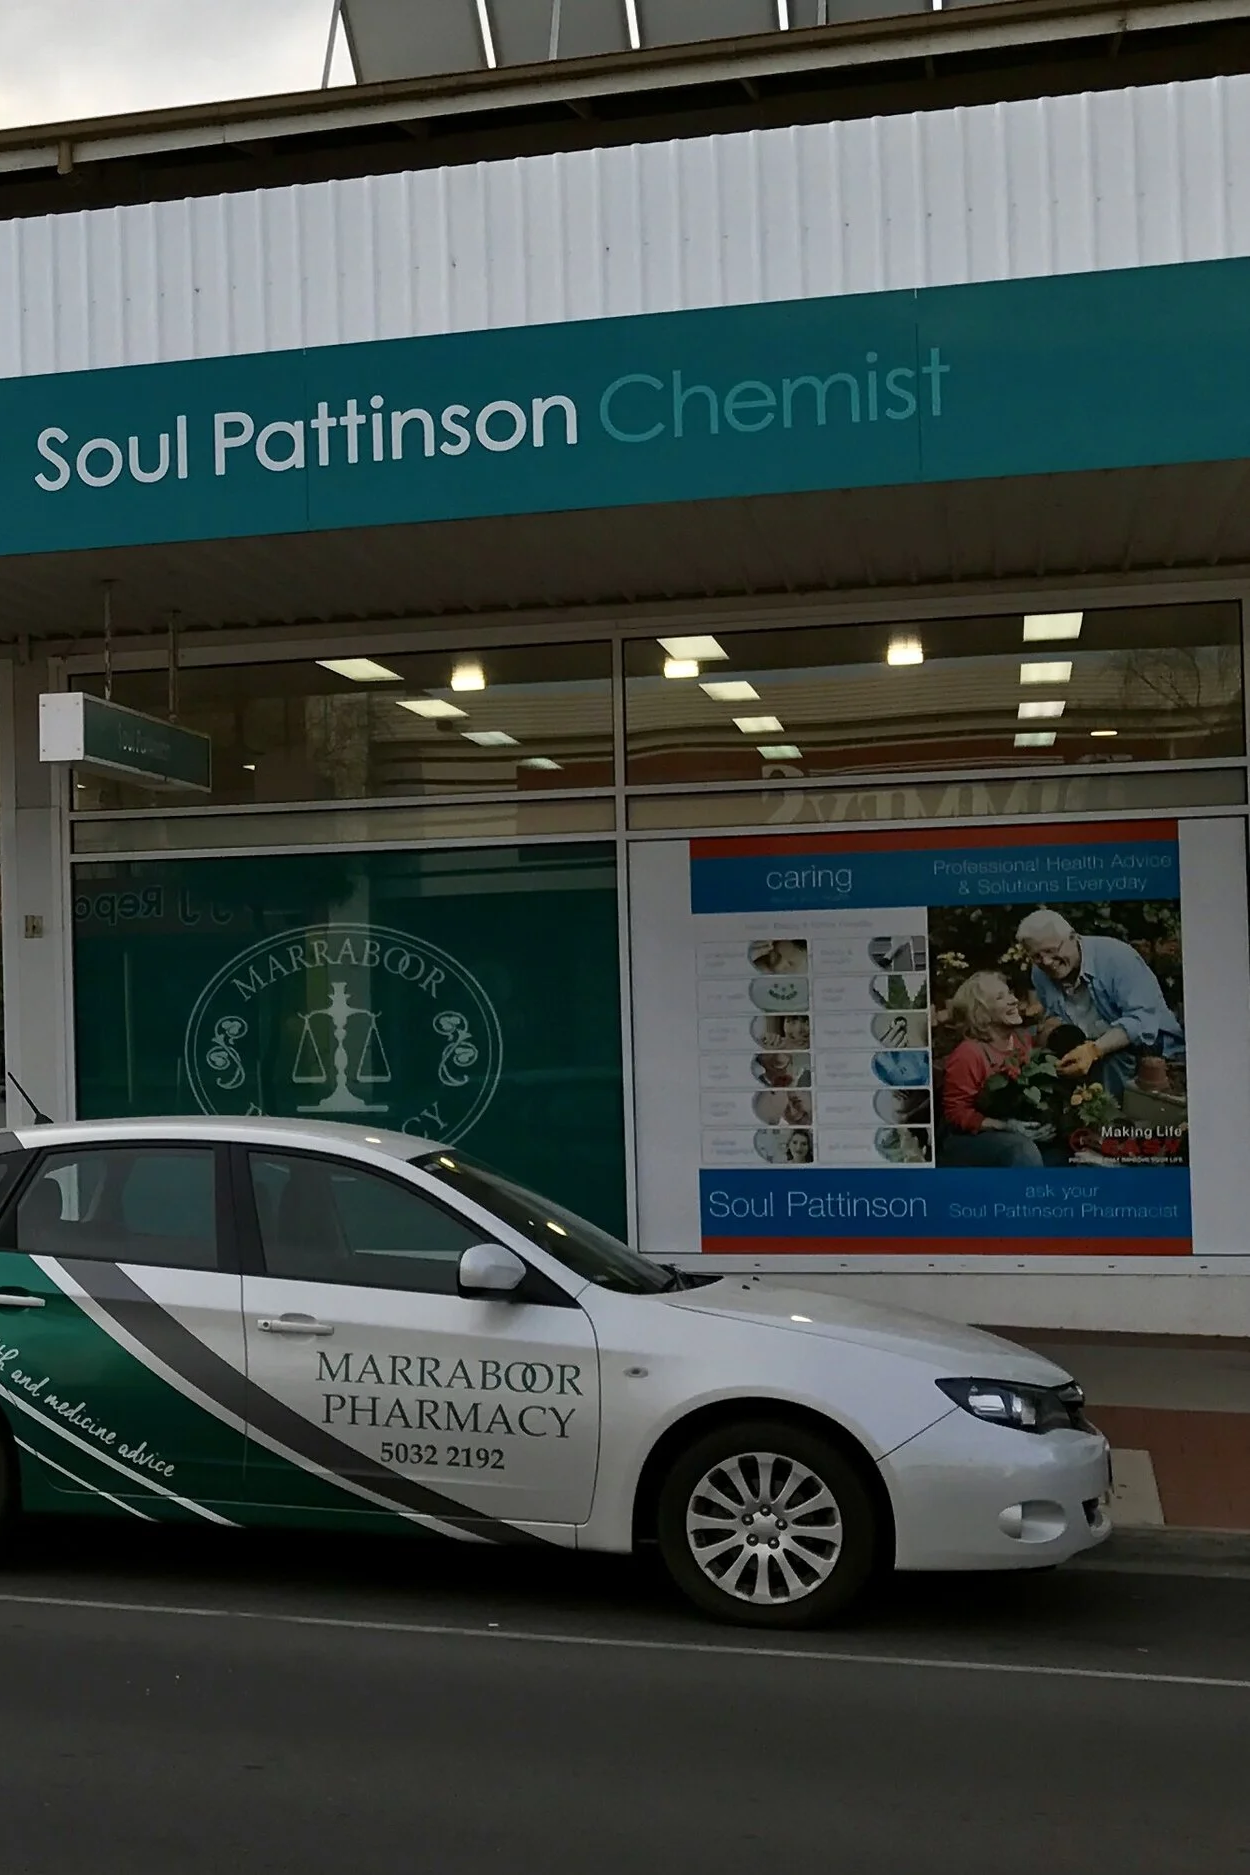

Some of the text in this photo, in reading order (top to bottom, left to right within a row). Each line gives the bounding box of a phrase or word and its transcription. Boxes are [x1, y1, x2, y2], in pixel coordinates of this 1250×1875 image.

[34, 347, 950, 492] Soul Pattinson Chemist
[766, 864, 852, 893] caring
[933, 853, 1172, 876] Professional Health Advice
[958, 875, 1148, 896] & Solutions Everyday
[229, 937, 446, 1002] MARRABOOR
[1101, 1125, 1182, 1139] Making Life
[709, 1191, 928, 1218] Soul Pattinson
[1025, 1184, 1100, 1200] ask your
[949, 1203, 1179, 1219] Soul Pattinson Pharmacist
[315, 1351, 583, 1396] MARRABOOR
[11, 1369, 50, 1397] and
[44, 1394, 117, 1445] medicine
[118, 1442, 175, 1477] advice
[322, 1394, 576, 1438] PHARMACY
[380, 1442, 505, 1470] 5032 2192
